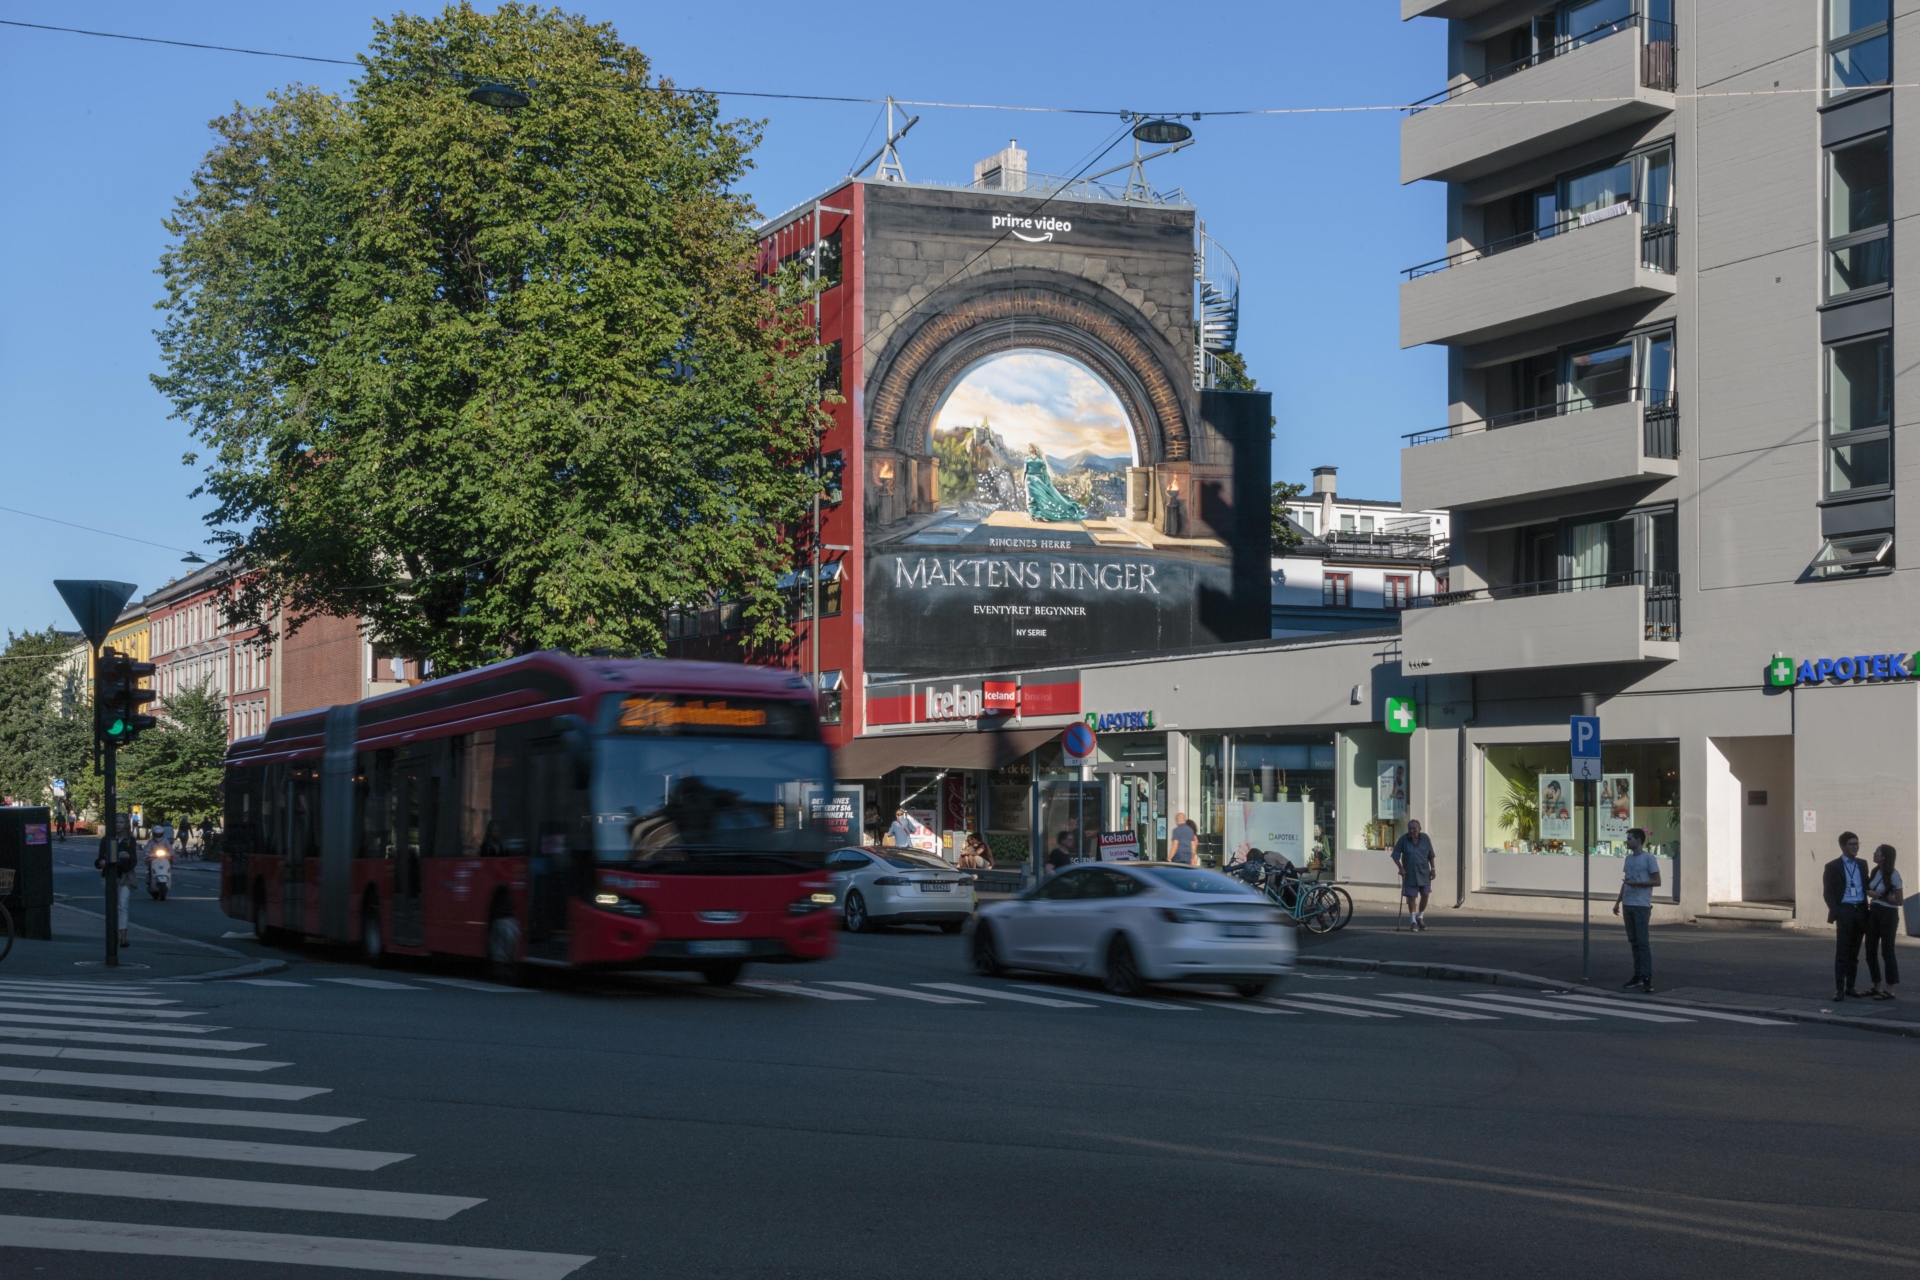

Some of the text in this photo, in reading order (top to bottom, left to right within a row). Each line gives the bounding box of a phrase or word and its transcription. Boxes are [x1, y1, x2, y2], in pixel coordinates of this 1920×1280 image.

[992, 213, 1072, 232] prime video
[989, 538, 1072, 549] RINGENES HERRE
[895, 557, 1160, 594] MAKTENS RINGER
[973, 605, 1086, 616] EVENTYRET BEGYNNER
[1016, 629, 1047, 637] NY SERIE
[1798, 653, 1908, 682] APOTEK
[984, 690, 1015, 701] Iceland
[926, 684, 999, 720] Icelan
[1098, 711, 1147, 730] APOTEK
[1578, 721, 1593, 752] P
[844, 811, 855, 819] TIL
[1100, 832, 1134, 844] Iceland
[1274, 833, 1295, 841] APOTEK
[1109, 849, 1131, 857] Iceland
